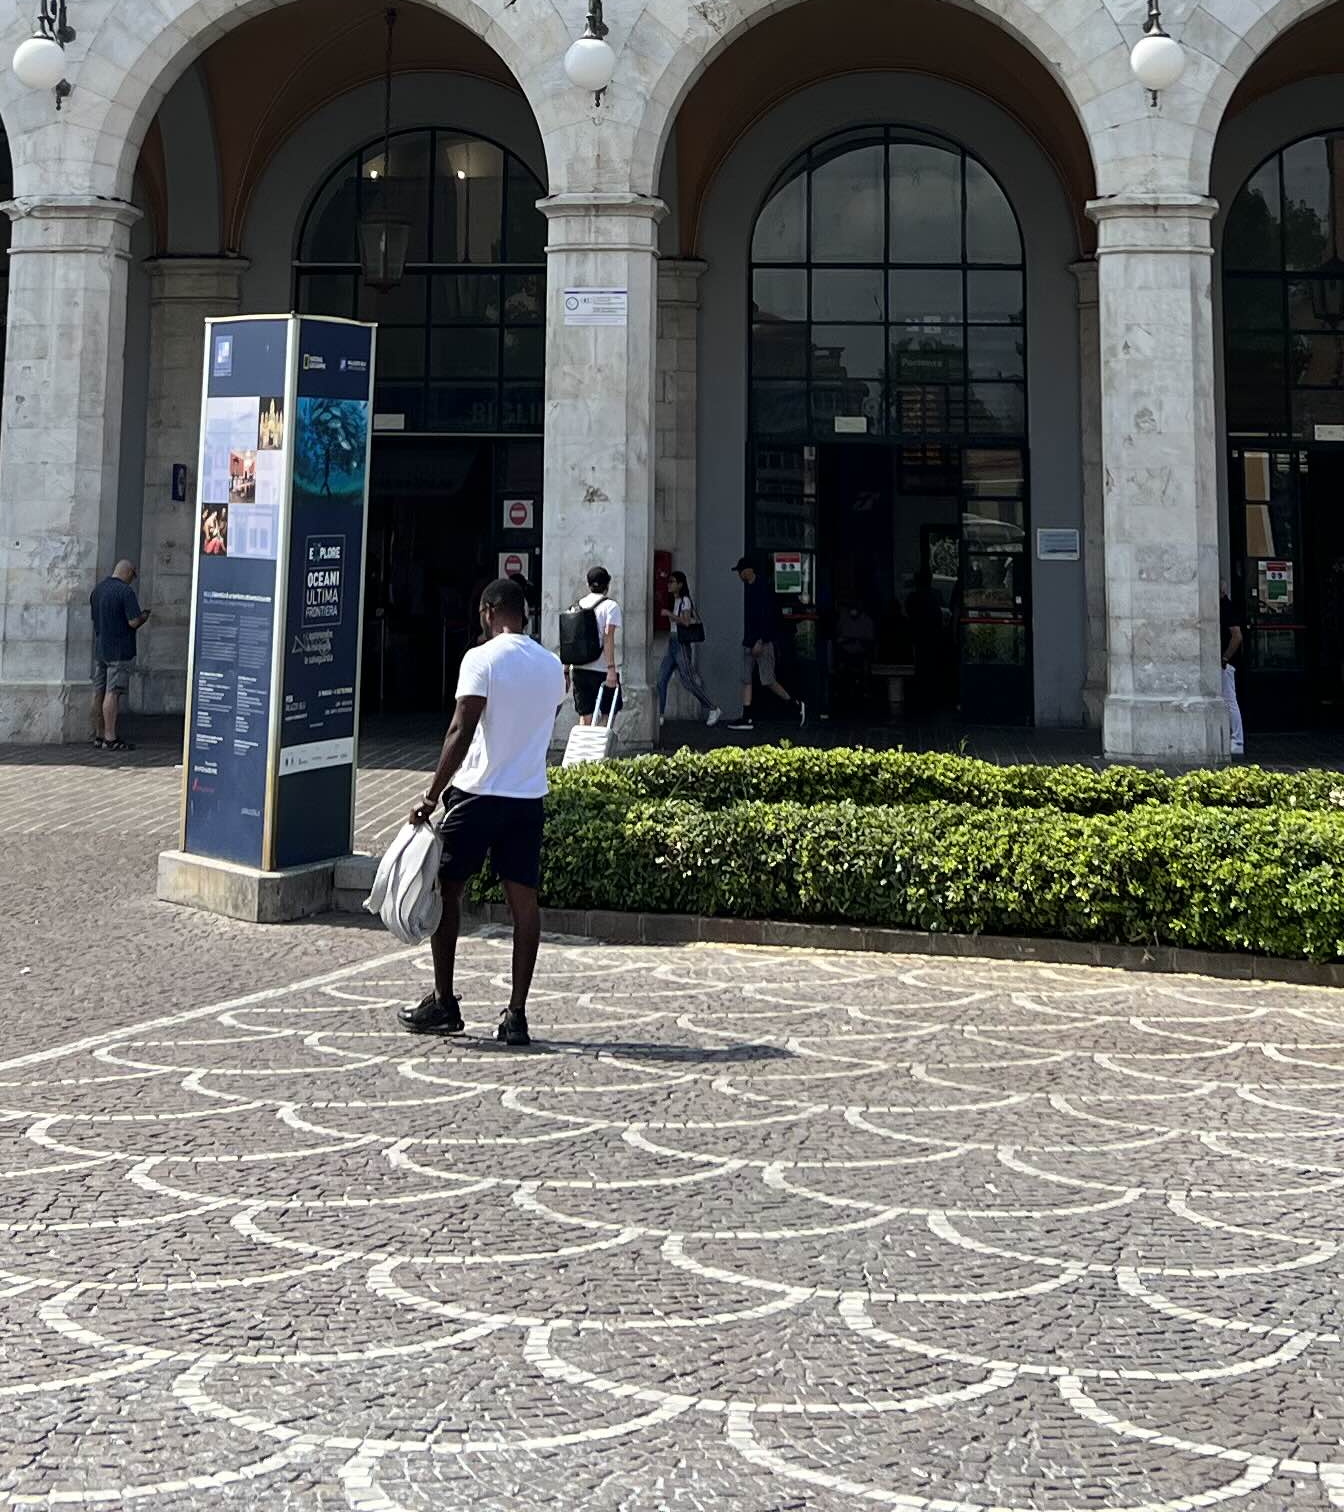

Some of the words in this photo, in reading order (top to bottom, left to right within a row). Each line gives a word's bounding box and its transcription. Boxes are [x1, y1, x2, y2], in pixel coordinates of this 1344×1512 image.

[307, 571, 340, 588] OCEANI
[306, 588, 339, 606] ULTIMA
[305, 605, 338, 618] FRONTIERA
